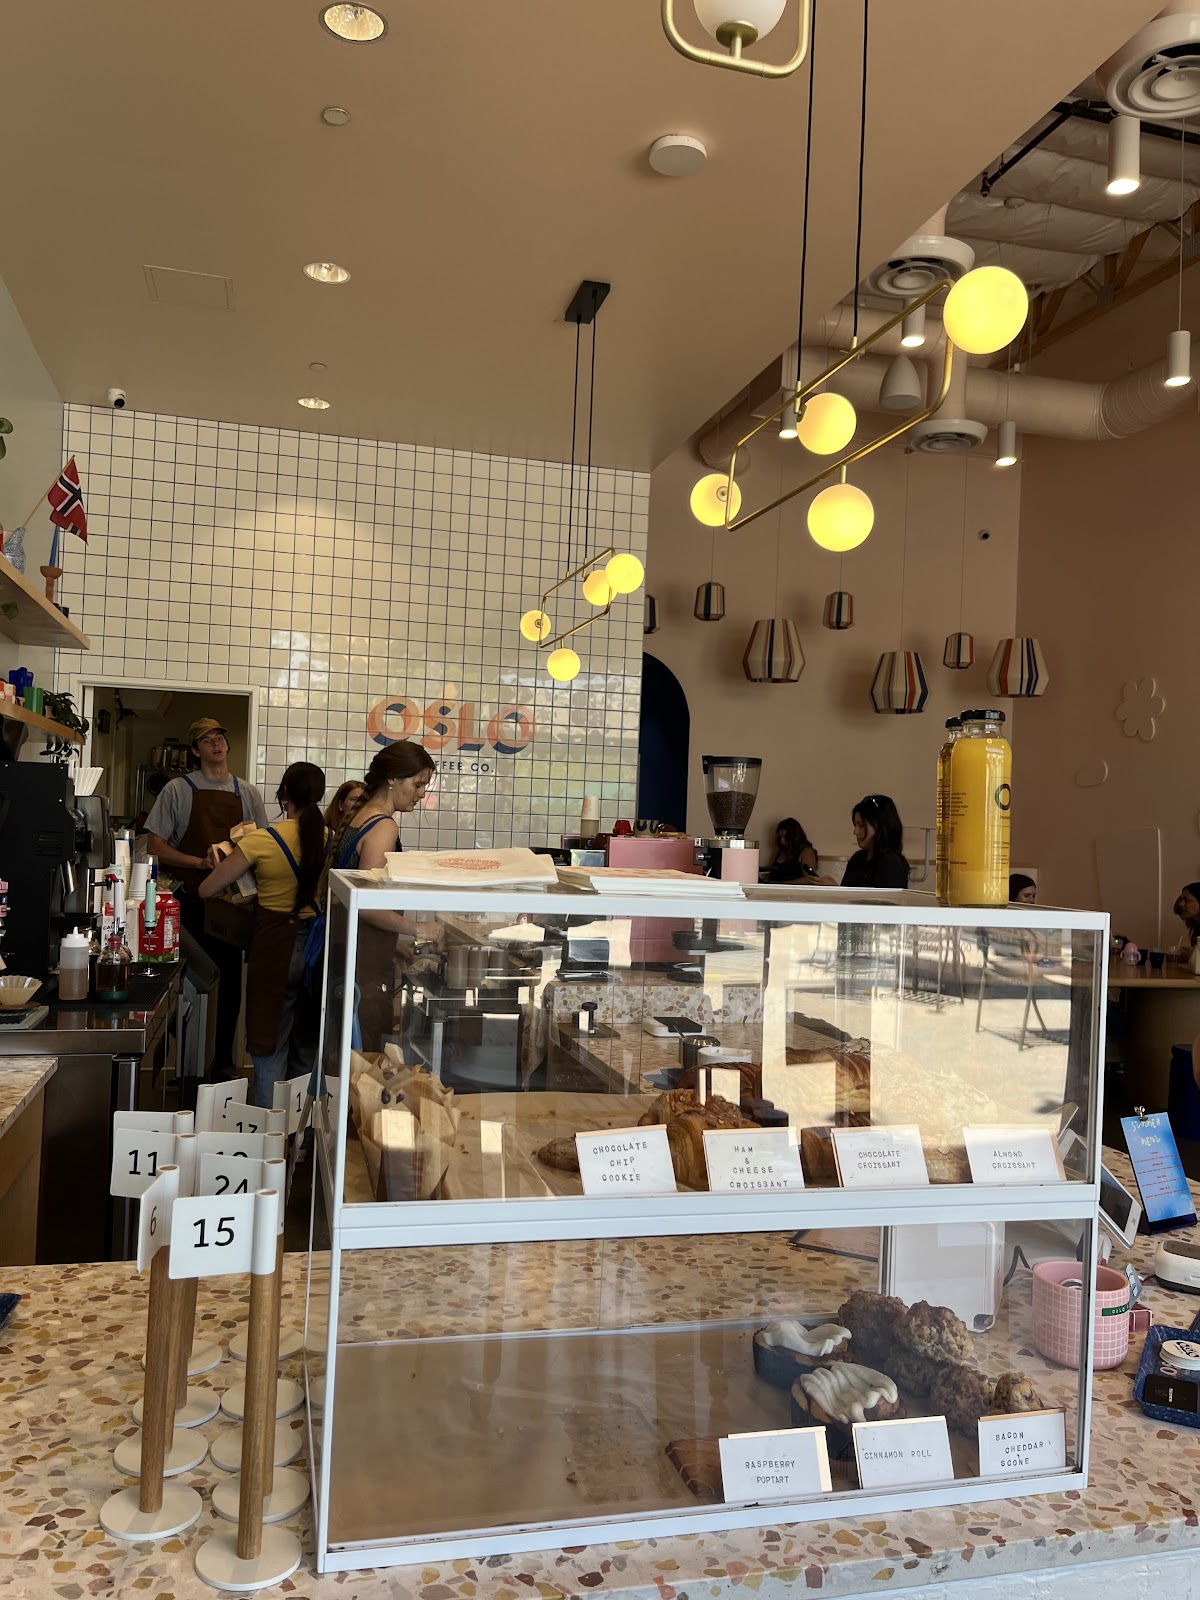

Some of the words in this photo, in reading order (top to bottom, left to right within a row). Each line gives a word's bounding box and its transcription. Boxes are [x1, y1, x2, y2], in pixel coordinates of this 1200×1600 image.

[367, 695, 537, 755] OSLO
[434, 760, 463, 771] FFEE
[470, 762, 494, 773] CO.
[592, 1141, 648, 1155] CHOCOLATE
[734, 1145, 754, 1154] HAM
[858, 1150, 901, 1159] CHOCOLATE
[993, 1150, 1023, 1158] ALMOND
[128, 1149, 158, 1176] 11
[609, 1156, 636, 1167] CHIP
[857, 1161, 901, 1170] CROISSANT
[992, 1162, 1036, 1170] CROISSANT
[732, 1166, 774, 1174] CHEESE
[601, 1173, 641, 1182] COOKIE
[729, 1180, 789, 1189] CROISSANT
[149, 1205, 158, 1237] 6
[192, 1216, 236, 1249] 15
[995, 1431, 1025, 1442] BACON
[1004, 1441, 1044, 1455] CHEDDAR
[864, 1450, 904, 1460] CINNAMON
[910, 1449, 932, 1459] ROLL
[744, 1460, 796, 1470] RASPBERRY
[1000, 1457, 1030, 1467] SCONE
[756, 1475, 790, 1484] POPTART
